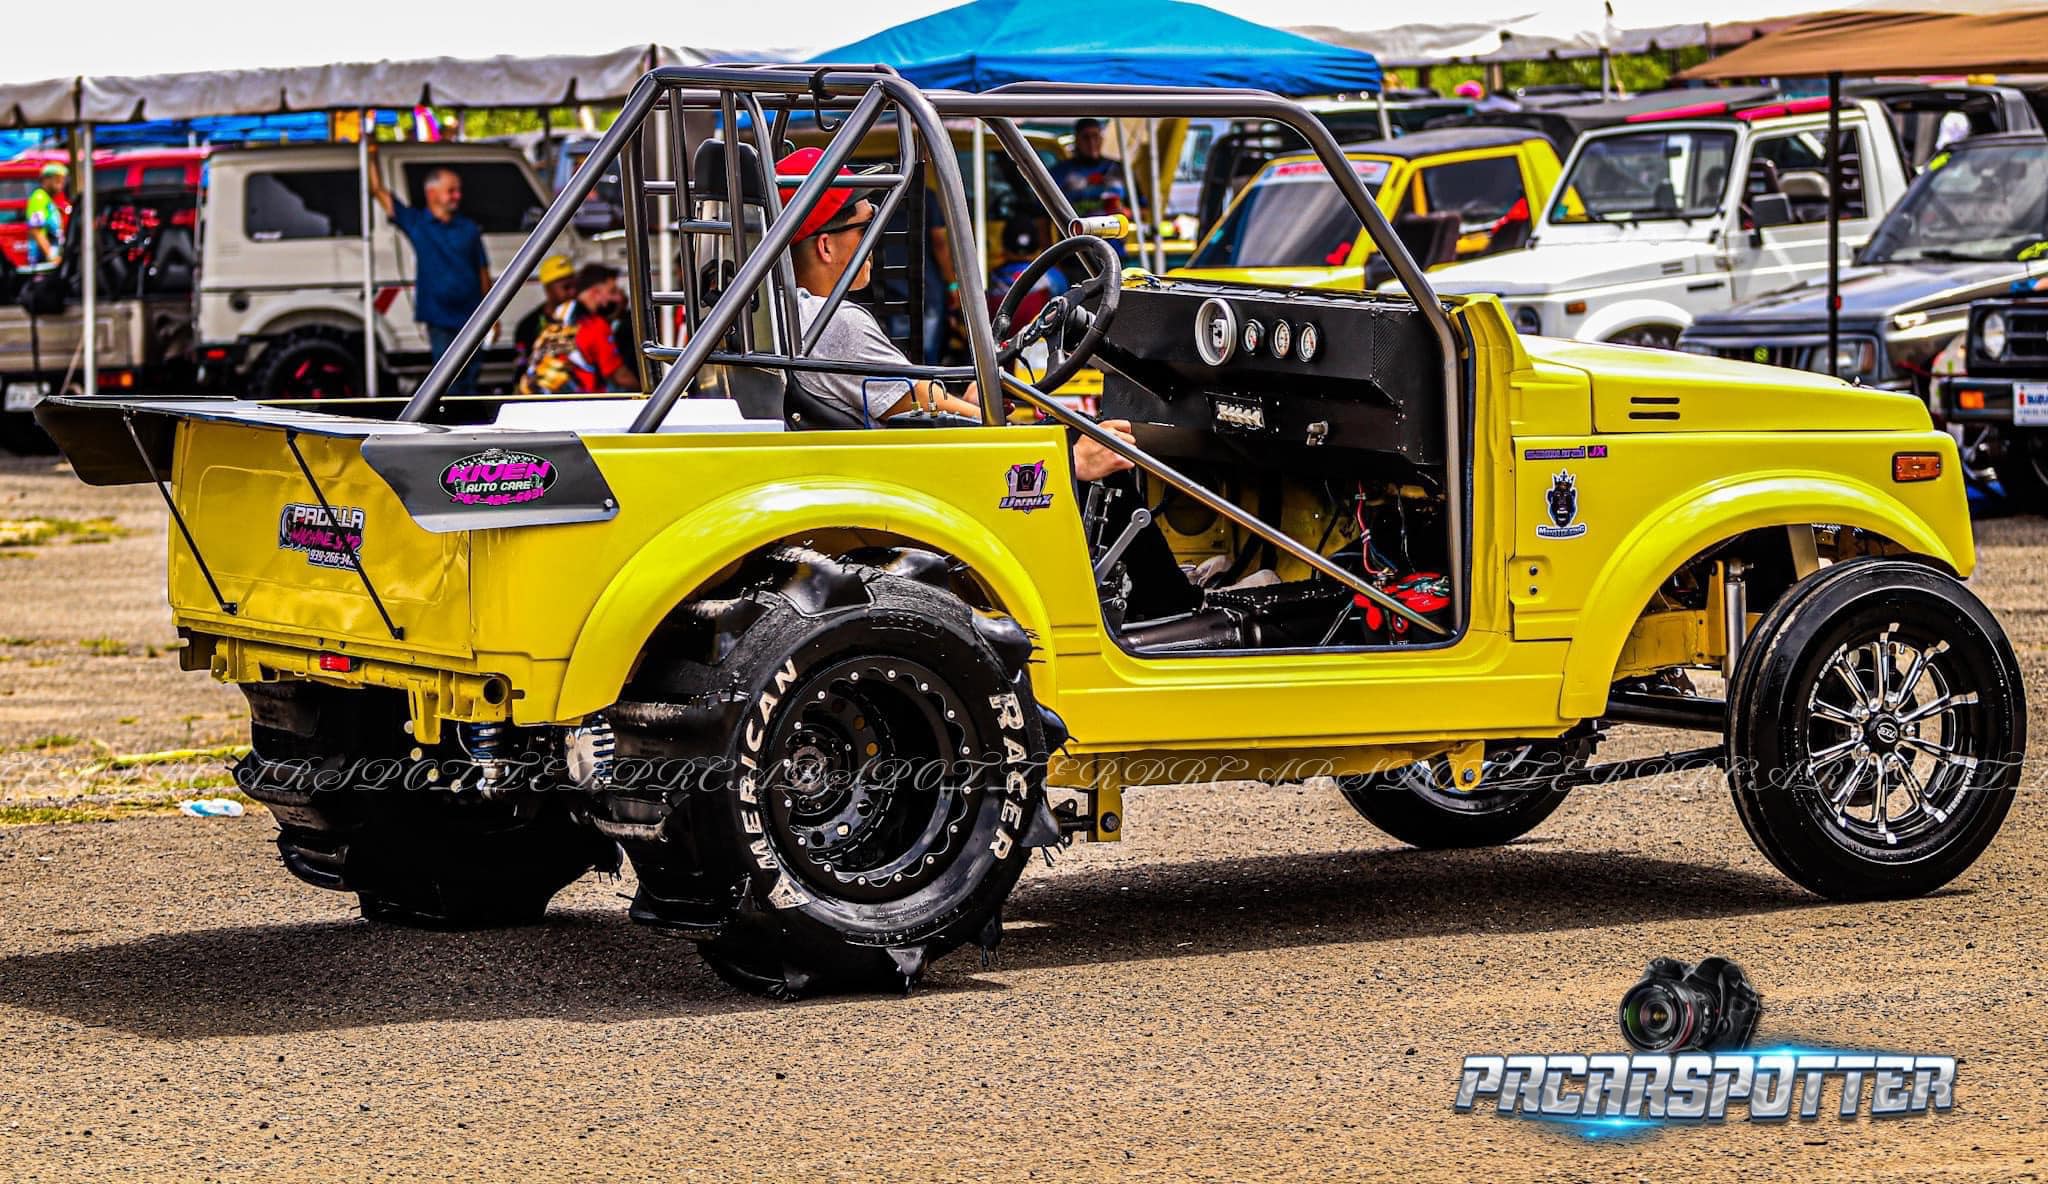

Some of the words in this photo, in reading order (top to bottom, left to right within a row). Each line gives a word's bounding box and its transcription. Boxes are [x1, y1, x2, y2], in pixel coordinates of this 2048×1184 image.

[1588, 445, 1606, 458] JX
[466, 482, 498, 493] AUTO
[500, 480, 531, 491] CARE
[739, 658, 811, 910] AMERICAN
[988, 691, 1029, 861] RACER
